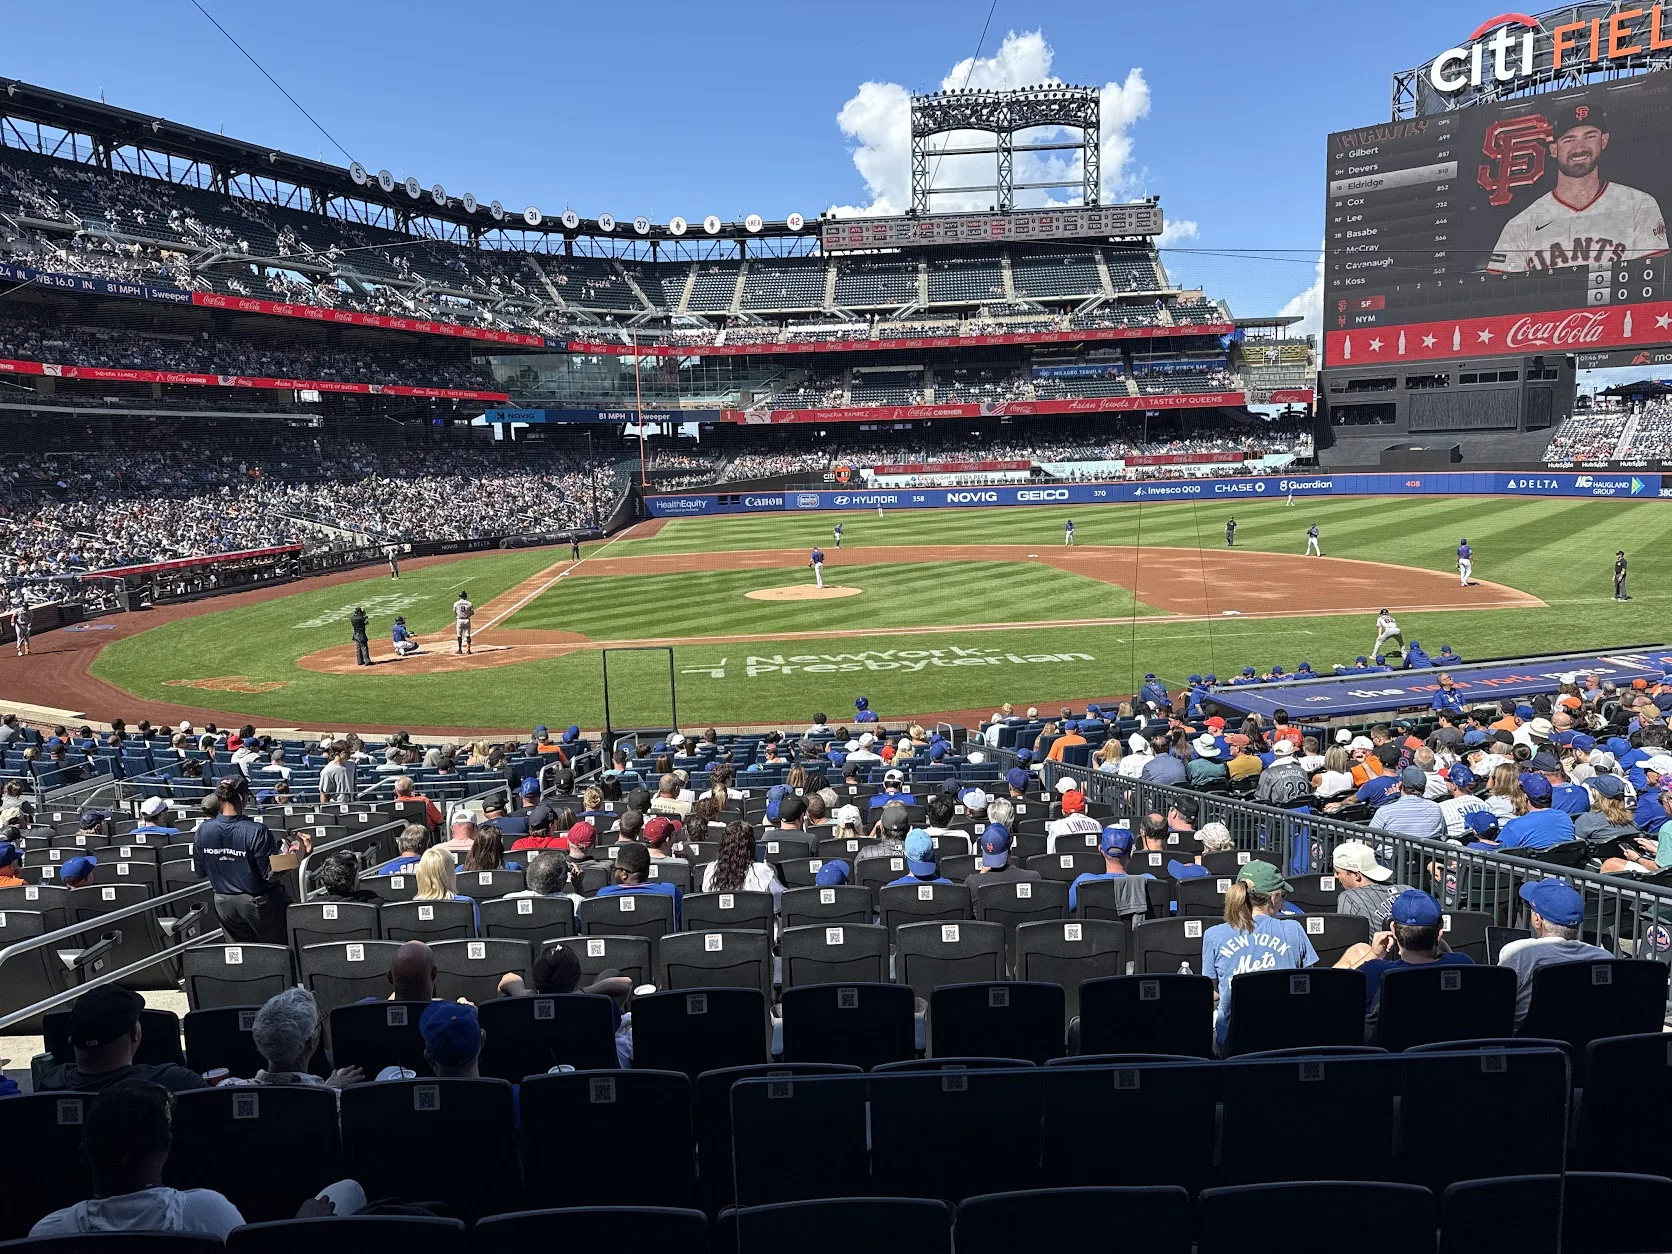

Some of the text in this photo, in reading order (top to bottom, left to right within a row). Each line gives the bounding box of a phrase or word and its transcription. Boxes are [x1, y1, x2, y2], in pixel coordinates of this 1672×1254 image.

[1431, 24, 1534, 91] citi
[1349, 147, 1378, 158] Gilbert
[355, 168, 361, 179] 5
[1348, 163, 1378, 174] Devers
[382, 176, 390, 186] 18
[1348, 179, 1383, 190] Eldridge
[409, 183, 417, 193] 16
[435, 190, 444, 200] 24
[467, 198, 473, 207] 17
[1347, 198, 1364, 206] Cox
[493, 206, 501, 215] 36
[529, 212, 537, 220] 31
[566, 215, 574, 223] 41
[602, 218, 611, 226] 14
[637, 221, 646, 229] 37
[1347, 228, 1377, 238] Basabe
[1346, 244, 1379, 254] McCray
[1345, 258, 1393, 269] Cavanaugh
[1345, 277, 1365, 285] Koss
[17, 271, 28, 280] IN.
[55, 277, 74, 287] 16.0
[82, 281, 95, 289] IN.
[107, 284, 116, 292] 81
[119, 286, 140, 295] MPH
[152, 290, 189, 302] Sweeper
[1361, 270, 1652, 308] SF 0 0 0
[1355, 287, 1651, 323] NYM 0 0 0
[1507, 311, 1611, 347] Coca-Cola
[1068, 401, 1097, 410] Asian
[1100, 399, 1129, 410] Jewels
[1189, 396, 1222, 404] QUEENS
[907, 408, 932, 417] Coca-Cola
[823, 472, 835, 480] citi
[1215, 484, 1253, 492] CHASE
[1289, 480, 1332, 490] Guardian
[1519, 480, 1558, 488] DELTA
[1017, 489, 1068, 500] GEICO
[1148, 486, 1181, 494] Invesco
[745, 497, 783, 507] Canon
[853, 496, 897, 504] HYUNDAI
[947, 492, 997, 503] NOVIG
[657, 500, 706, 508] HealthEquity
[746, 652, 1096, 677] Presbyterian
[1348, 686, 1406, 699] the
[1413, 681, 1472, 692] nw
[1475, 673, 1535, 686] york
[1284, 781, 1307, 799] 28
[1067, 820, 1098, 833] LINDOR
[204, 848, 246, 857] HOSPITALITY
[1220, 933, 1291, 958] NEW YORK
[1234, 951, 1276, 974] Mets
